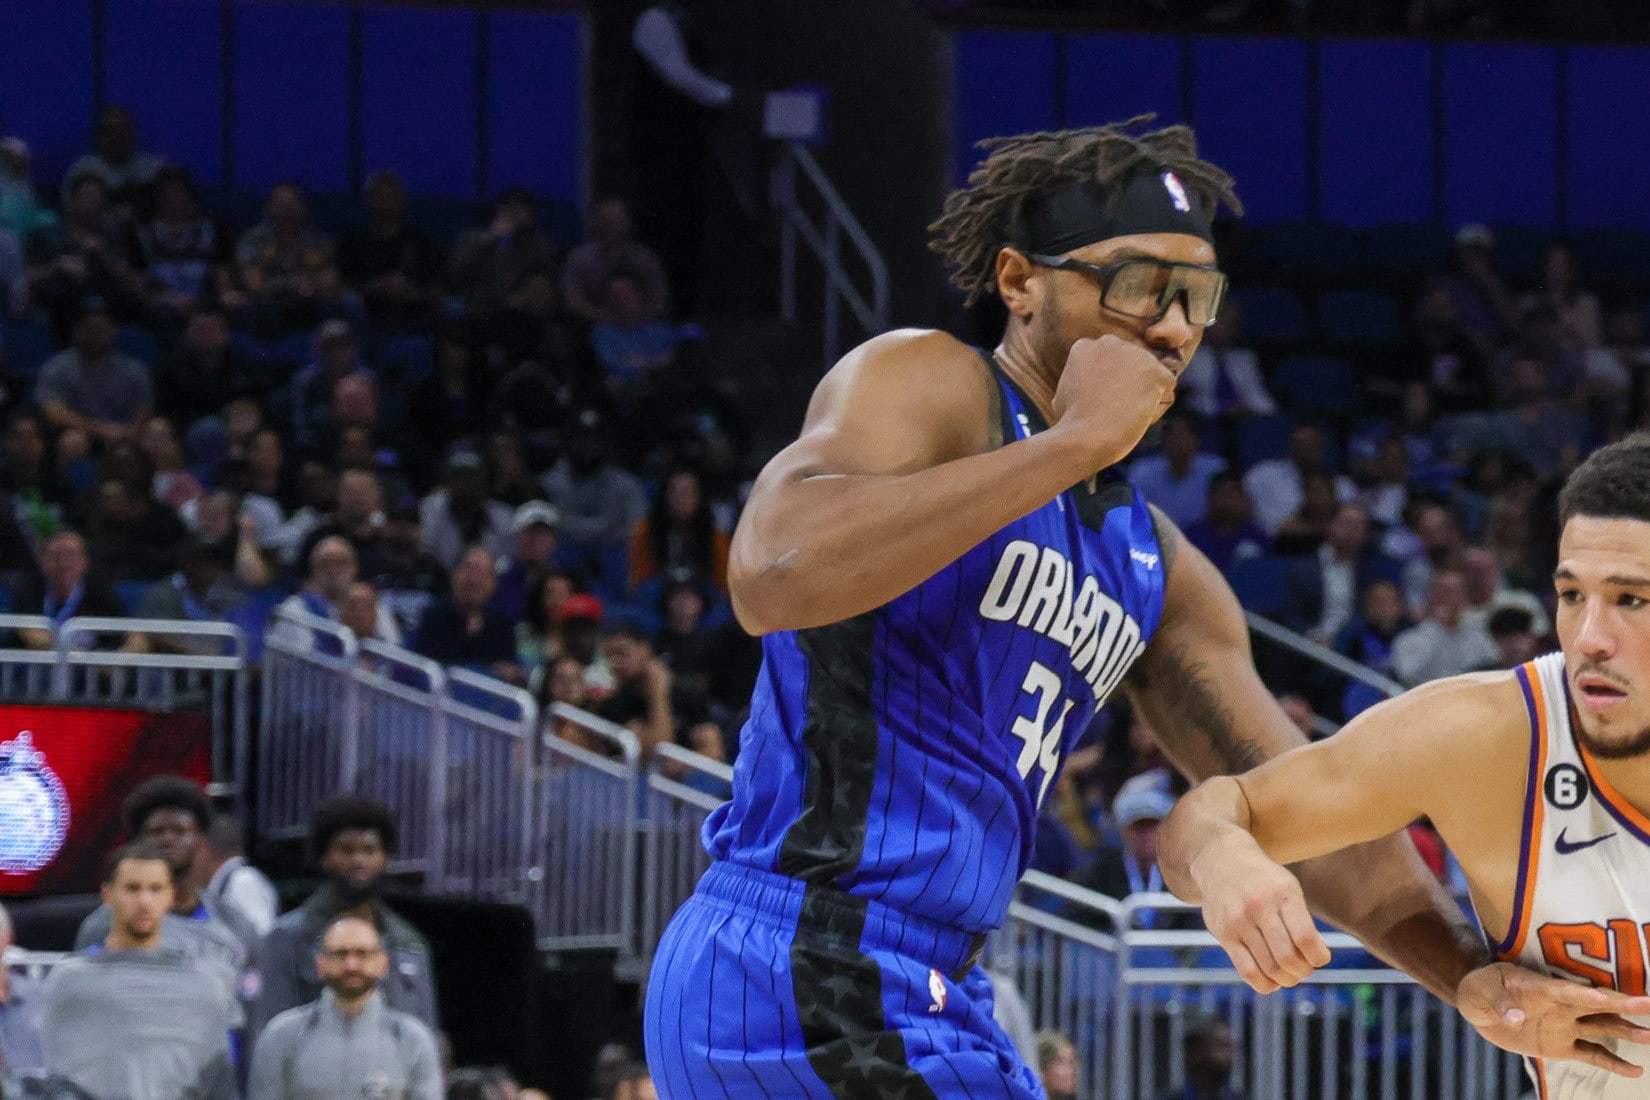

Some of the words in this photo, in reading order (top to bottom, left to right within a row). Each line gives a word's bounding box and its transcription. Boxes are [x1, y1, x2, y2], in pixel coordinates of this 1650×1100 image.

[979, 540, 1146, 713] ORLAND
[1011, 660, 1075, 810] 34
[1553, 769, 1578, 806] 6
